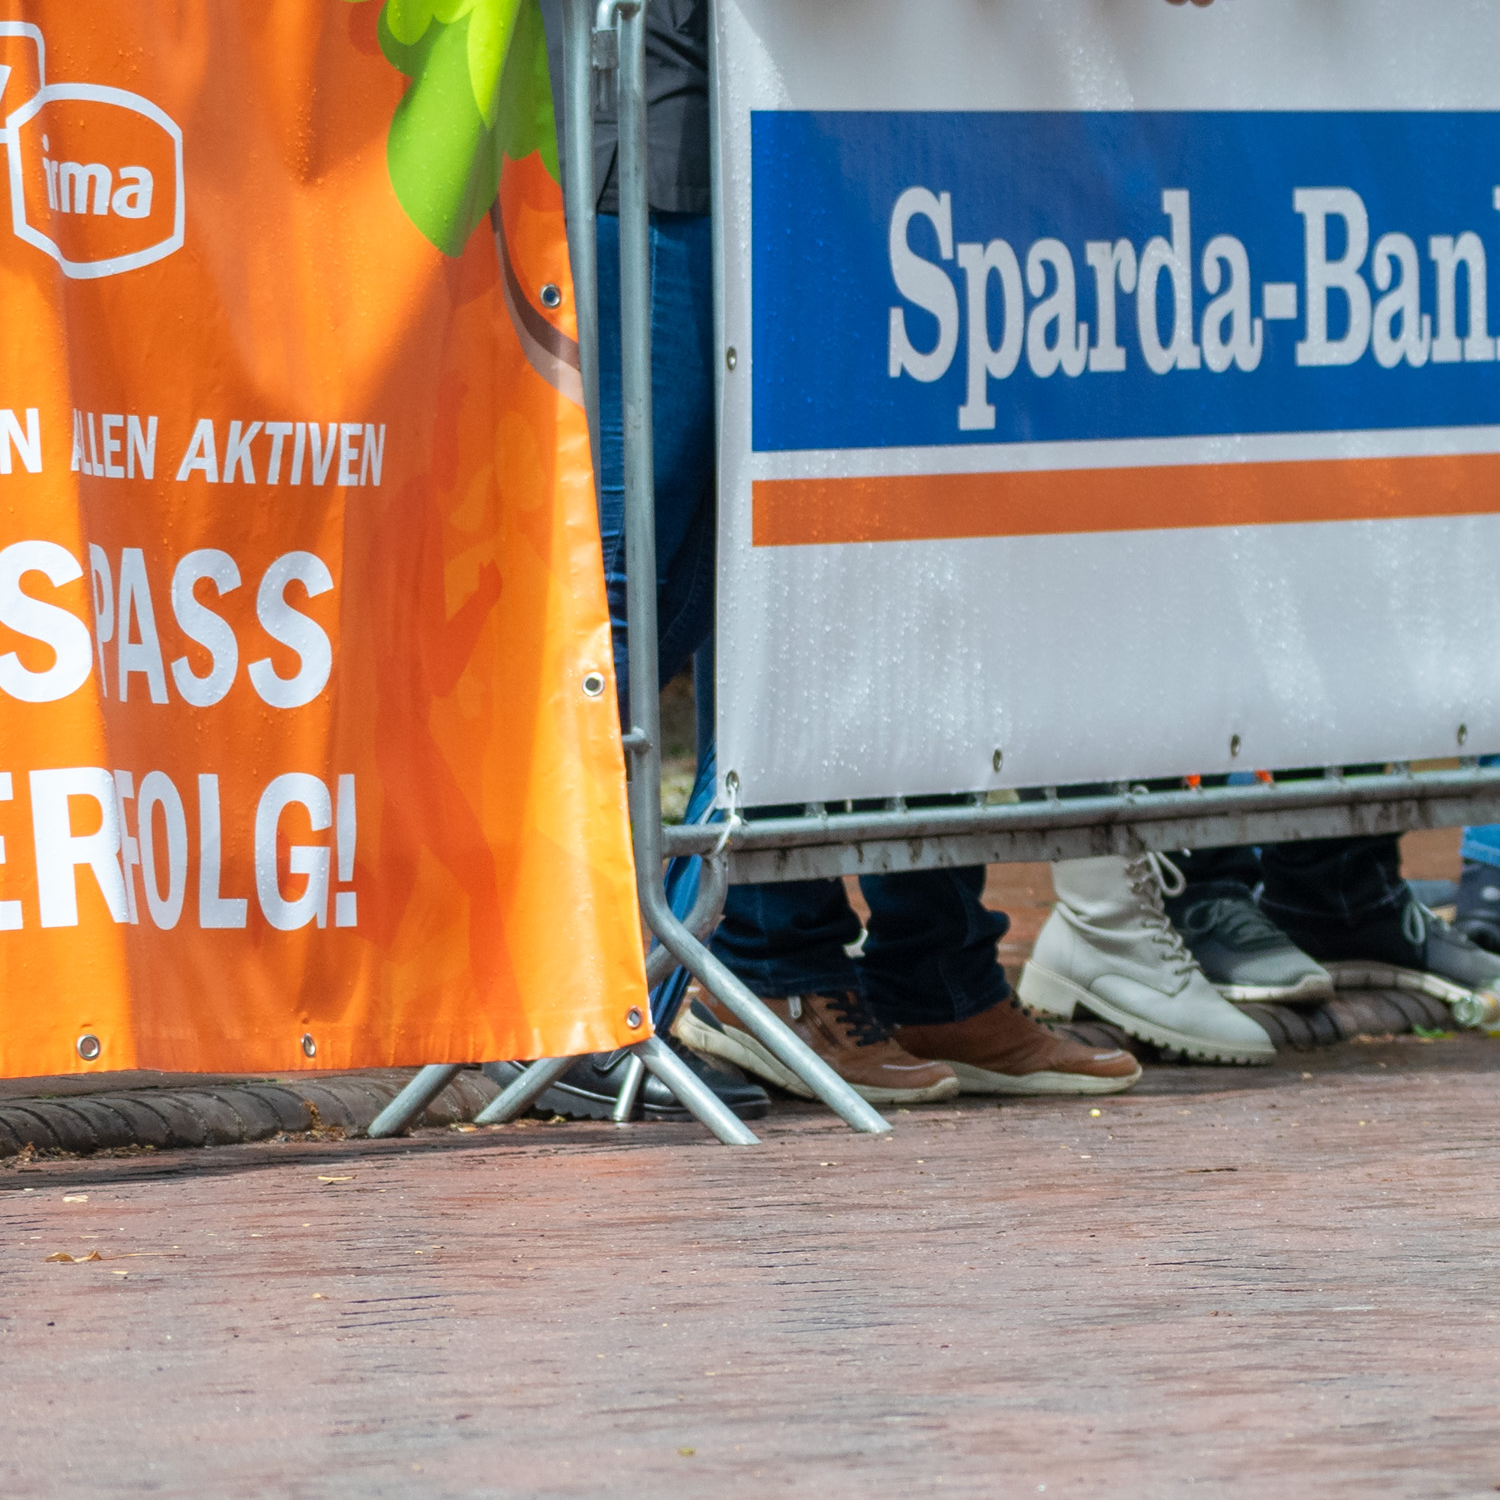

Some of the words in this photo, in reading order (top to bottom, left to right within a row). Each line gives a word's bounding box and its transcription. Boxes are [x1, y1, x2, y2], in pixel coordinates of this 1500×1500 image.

[42, 133, 154, 219] irma
[71, 408, 158, 480] ALLEN
[175, 418, 386, 487] AKTIVEN
